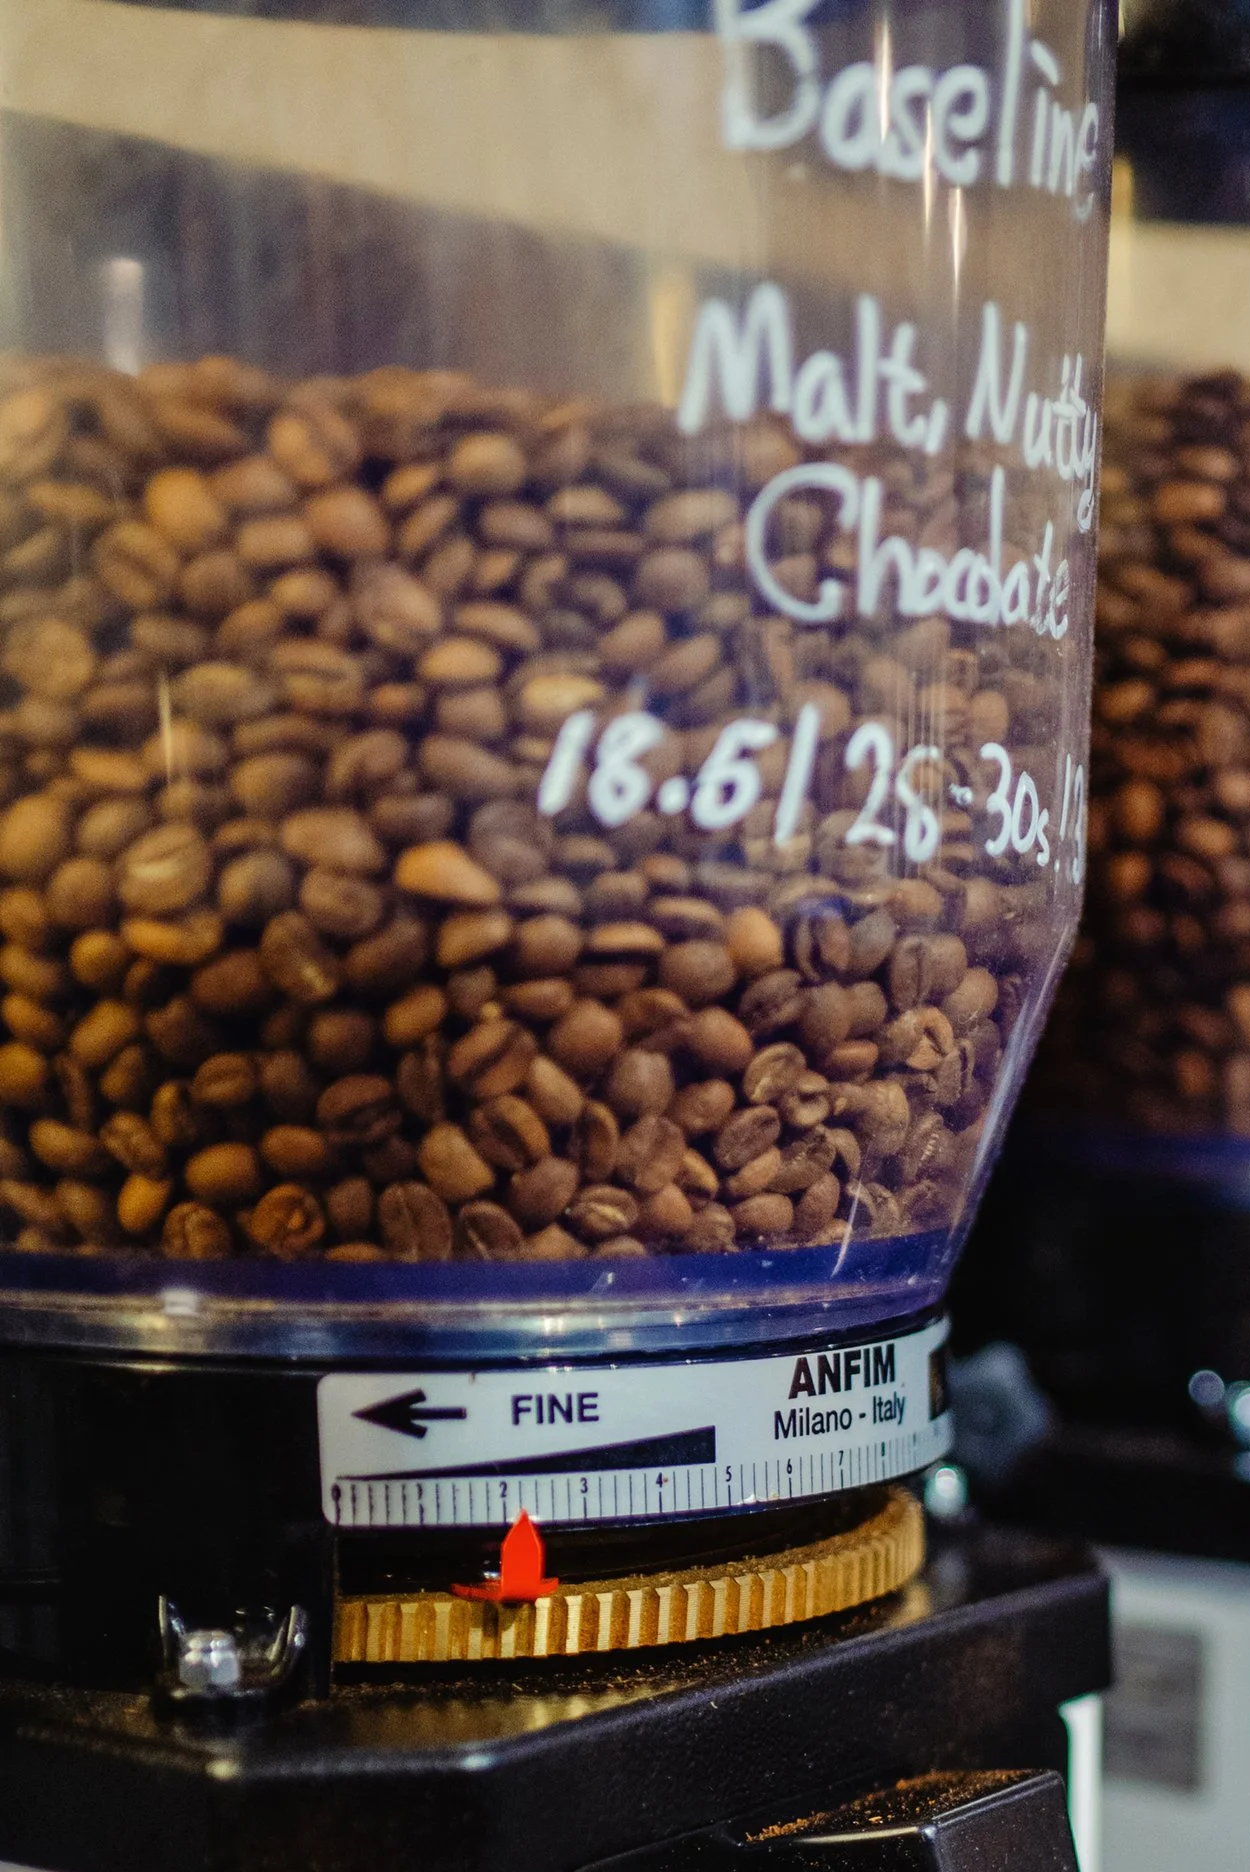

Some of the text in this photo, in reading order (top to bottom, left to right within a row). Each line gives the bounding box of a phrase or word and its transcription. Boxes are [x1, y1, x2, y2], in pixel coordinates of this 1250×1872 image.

[718, 0, 1099, 219] Baseline
[678, 282, 1097, 533] Malt, Nutty
[788, 1343, 896, 1399] ANFIM
[511, 1392, 600, 1426] FINE
[773, 1403, 852, 1440] Milano
[873, 1391, 905, 1426] Italy
[499, 1480, 508, 1498] 2
[579, 1476, 589, 1494] 3
[655, 1472, 663, 1488] 4
[725, 1465, 732, 1482] 5
[786, 1458, 793, 1475] 6
[838, 1450, 844, 1466] 7
